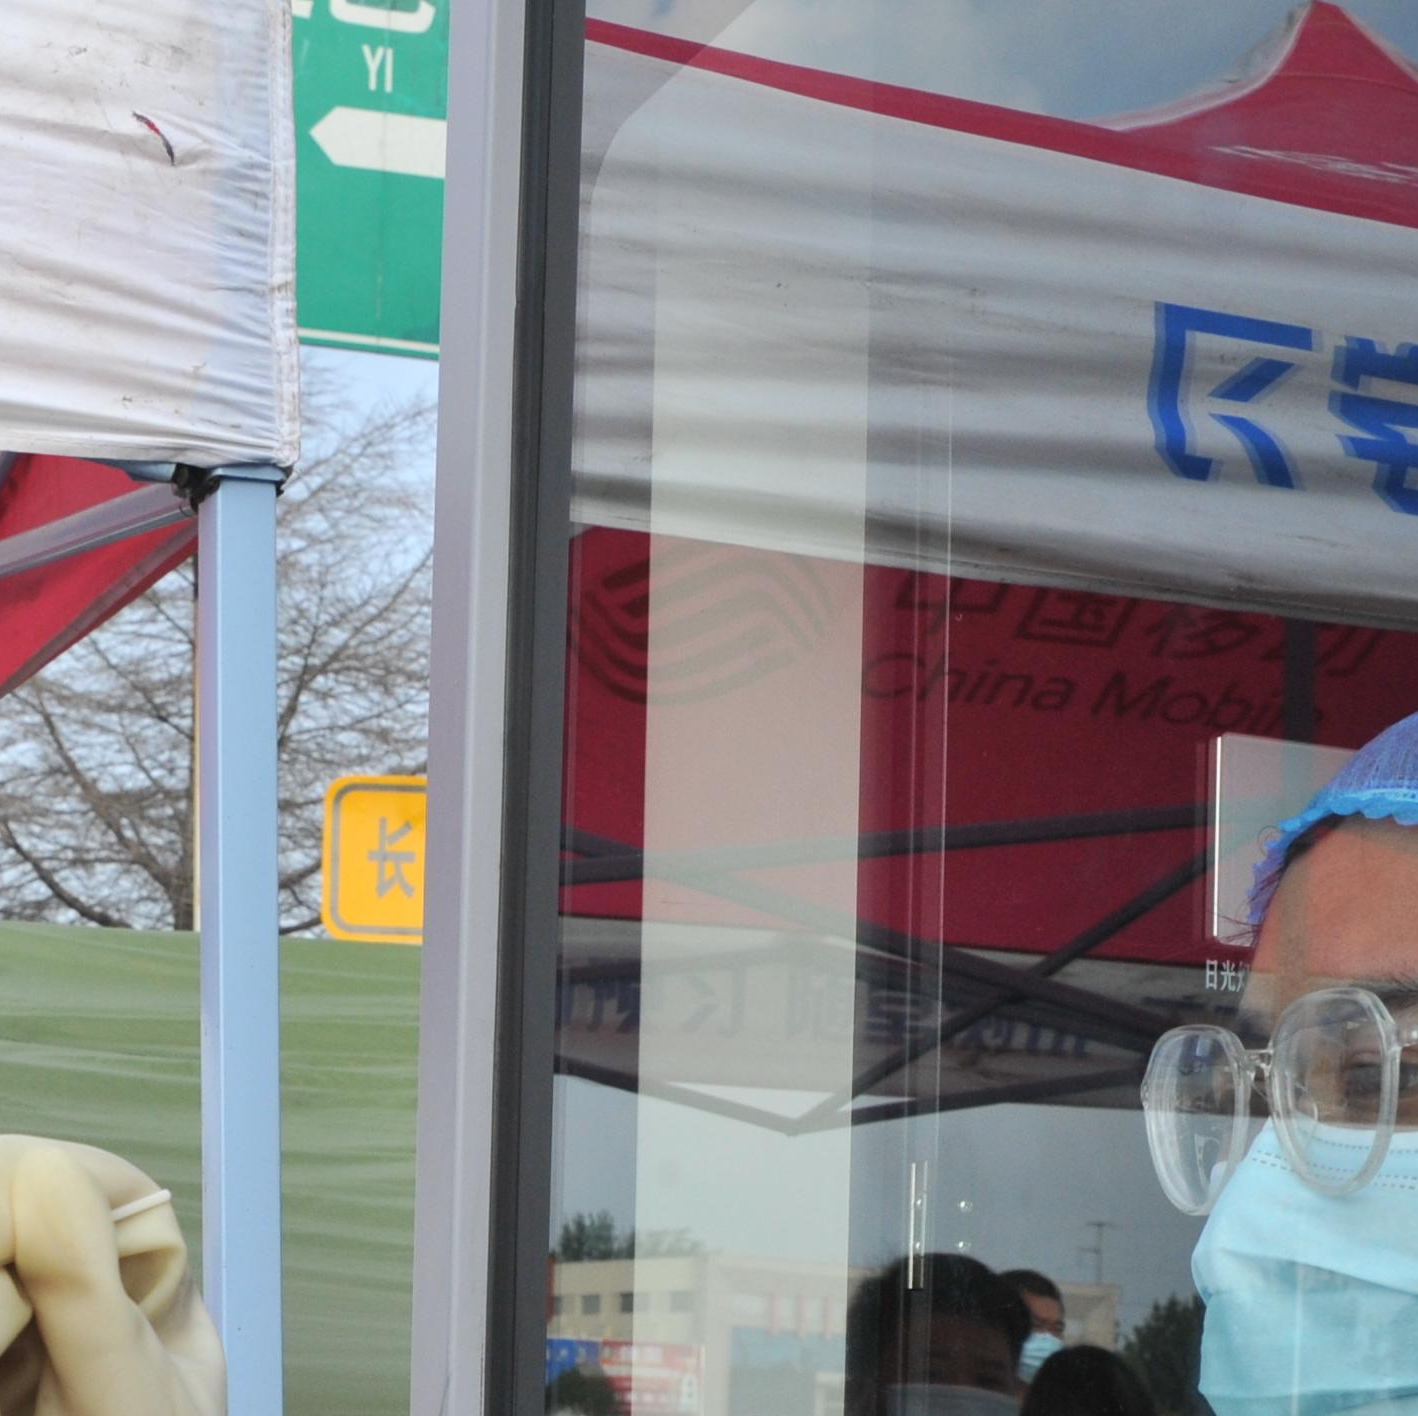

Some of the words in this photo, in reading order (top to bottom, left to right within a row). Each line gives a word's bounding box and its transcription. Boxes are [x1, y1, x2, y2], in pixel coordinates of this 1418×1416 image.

[362, 44, 394, 93] YI
[865, 650, 1078, 713] China
[1090, 671, 1324, 735] Mobil
[366, 816, 416, 898] 长
